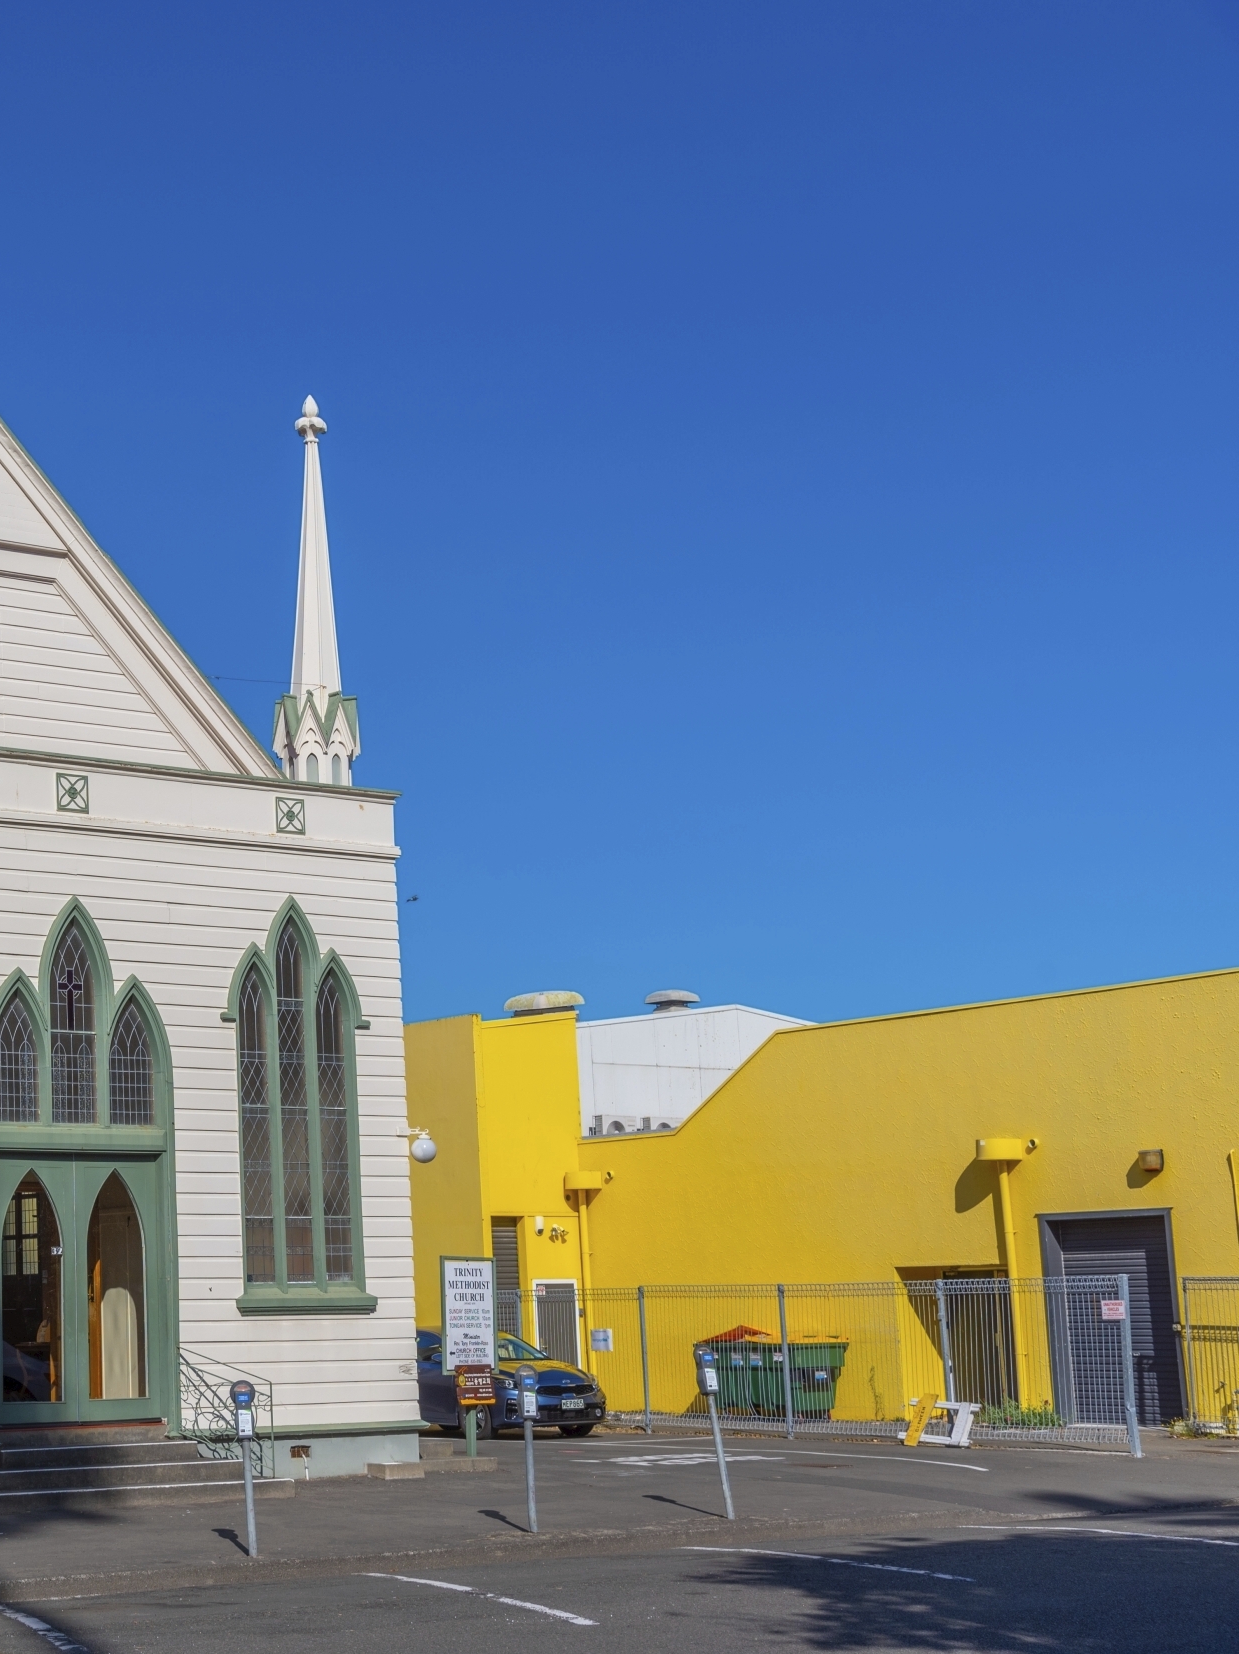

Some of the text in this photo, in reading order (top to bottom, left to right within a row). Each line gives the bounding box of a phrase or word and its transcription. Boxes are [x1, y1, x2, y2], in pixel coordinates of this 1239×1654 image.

[454, 1268, 483, 1277] TRINITY
[448, 1280, 490, 1290] METHODIST
[454, 1292, 484, 1301] CHURCH
[463, 1332, 480, 1340] Minister
